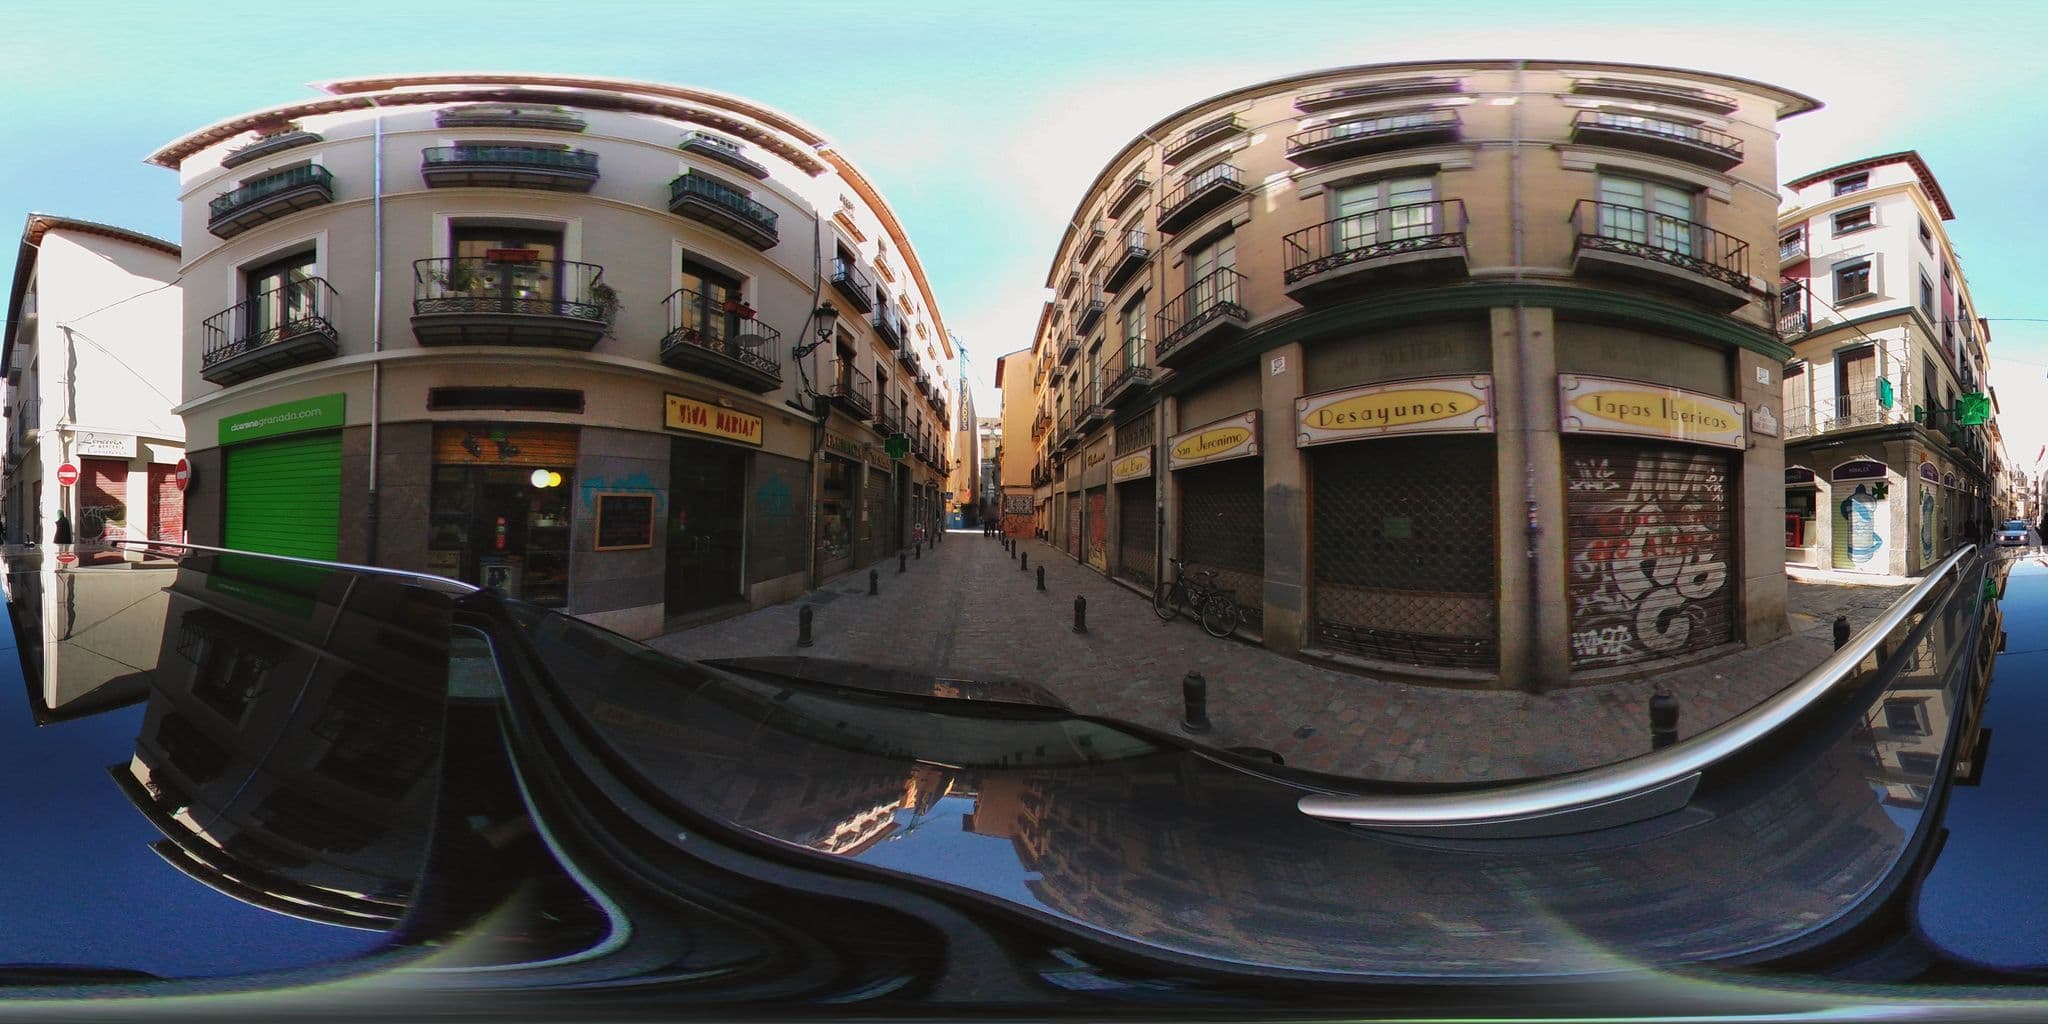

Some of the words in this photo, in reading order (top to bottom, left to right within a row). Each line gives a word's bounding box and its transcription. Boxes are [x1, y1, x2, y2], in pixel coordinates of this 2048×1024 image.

[1319, 401, 1458, 427] Desayunos
[1593, 395, 1652, 419] Tapas
[1197, 434, 1243, 452] Jeronimo
